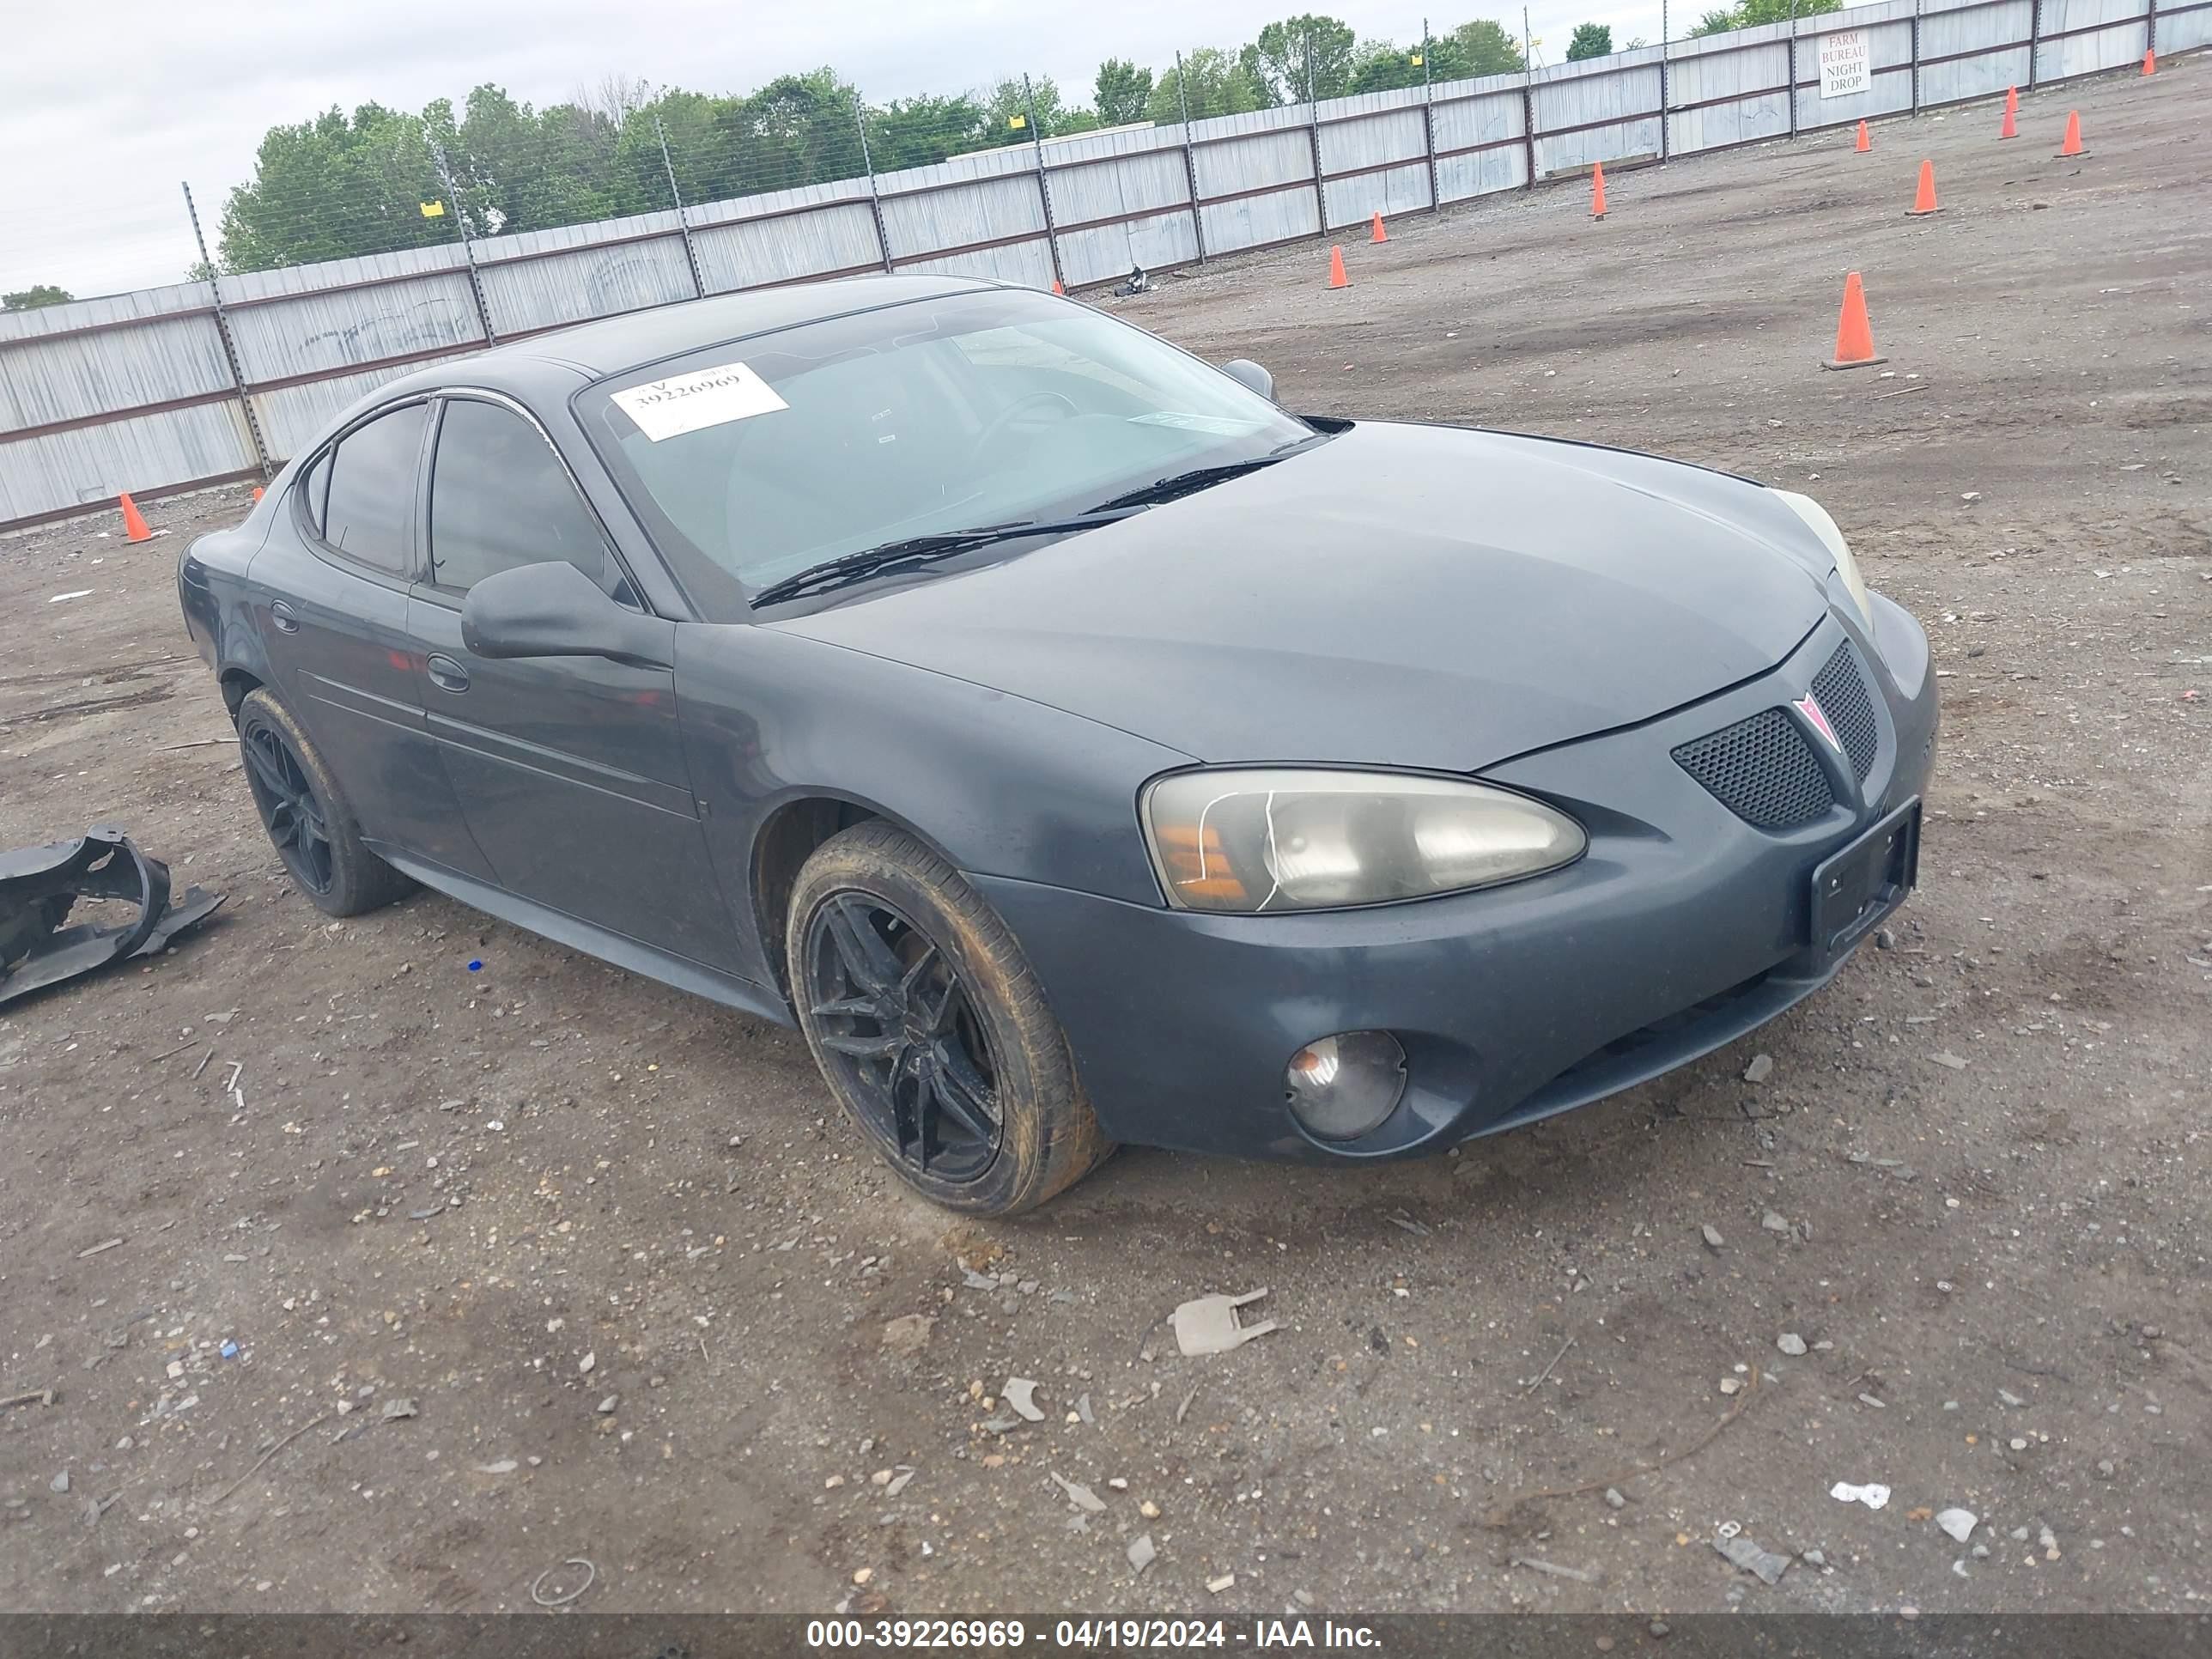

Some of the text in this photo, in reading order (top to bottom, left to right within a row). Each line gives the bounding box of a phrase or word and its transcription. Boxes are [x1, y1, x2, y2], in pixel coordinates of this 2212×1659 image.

[1829, 33, 1859, 48] FARM
[1822, 46, 1867, 64] BUREAU
[1826, 61, 1863, 78] NIGHT
[1831, 76, 1863, 91] DROP
[635, 374, 741, 409] 39226969
